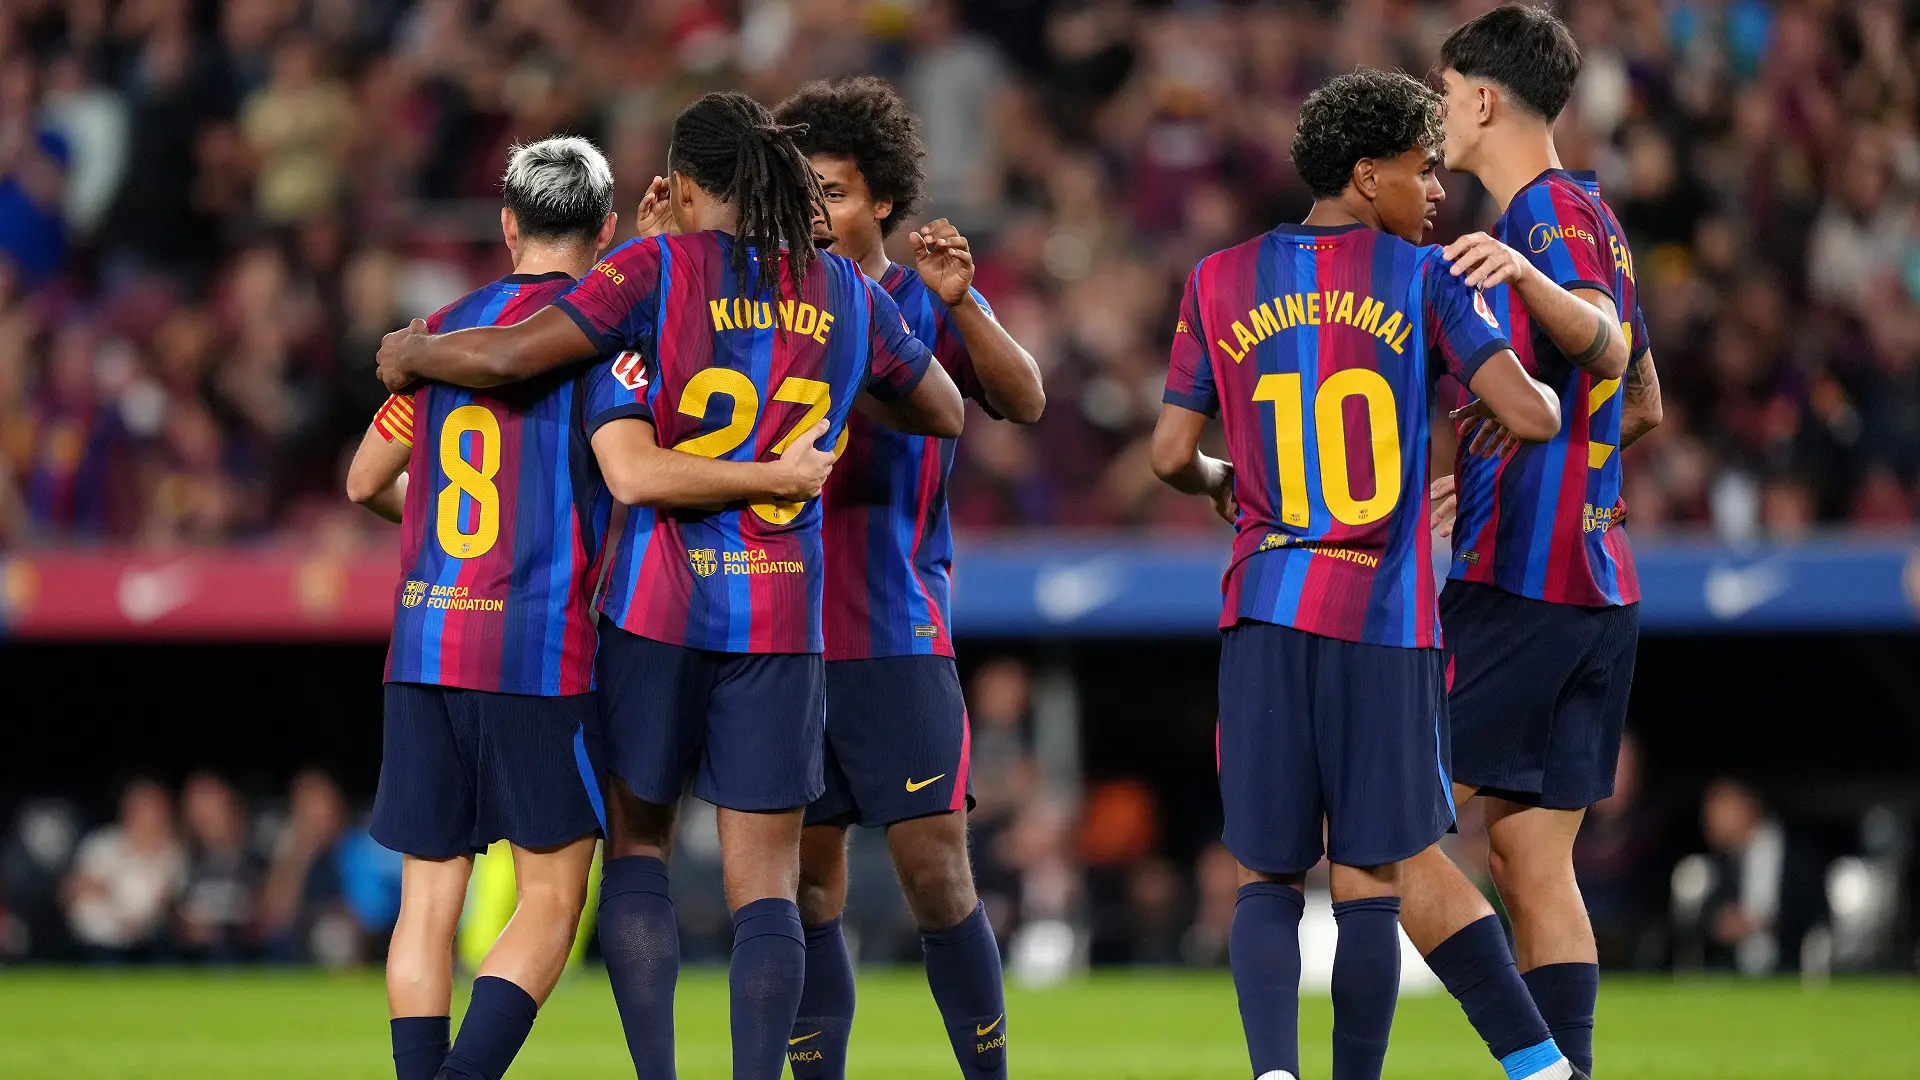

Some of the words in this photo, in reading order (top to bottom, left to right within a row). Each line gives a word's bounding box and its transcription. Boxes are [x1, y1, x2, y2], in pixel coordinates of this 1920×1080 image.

[1540, 224, 1596, 248] Midea
[709, 297, 835, 345] KOUNDE
[1218, 293, 1320, 364] LAMINE
[1325, 290, 1413, 355] YAMAL
[1251, 367, 1402, 528] 10
[436, 404, 501, 559] 8
[722, 549, 767, 563] BARÇA
[724, 561, 804, 575] FOUNDATION
[430, 585, 469, 599] BARÇA
[426, 597, 504, 611] FOUNDATION
[977, 1034, 1006, 1054] BARÇ
